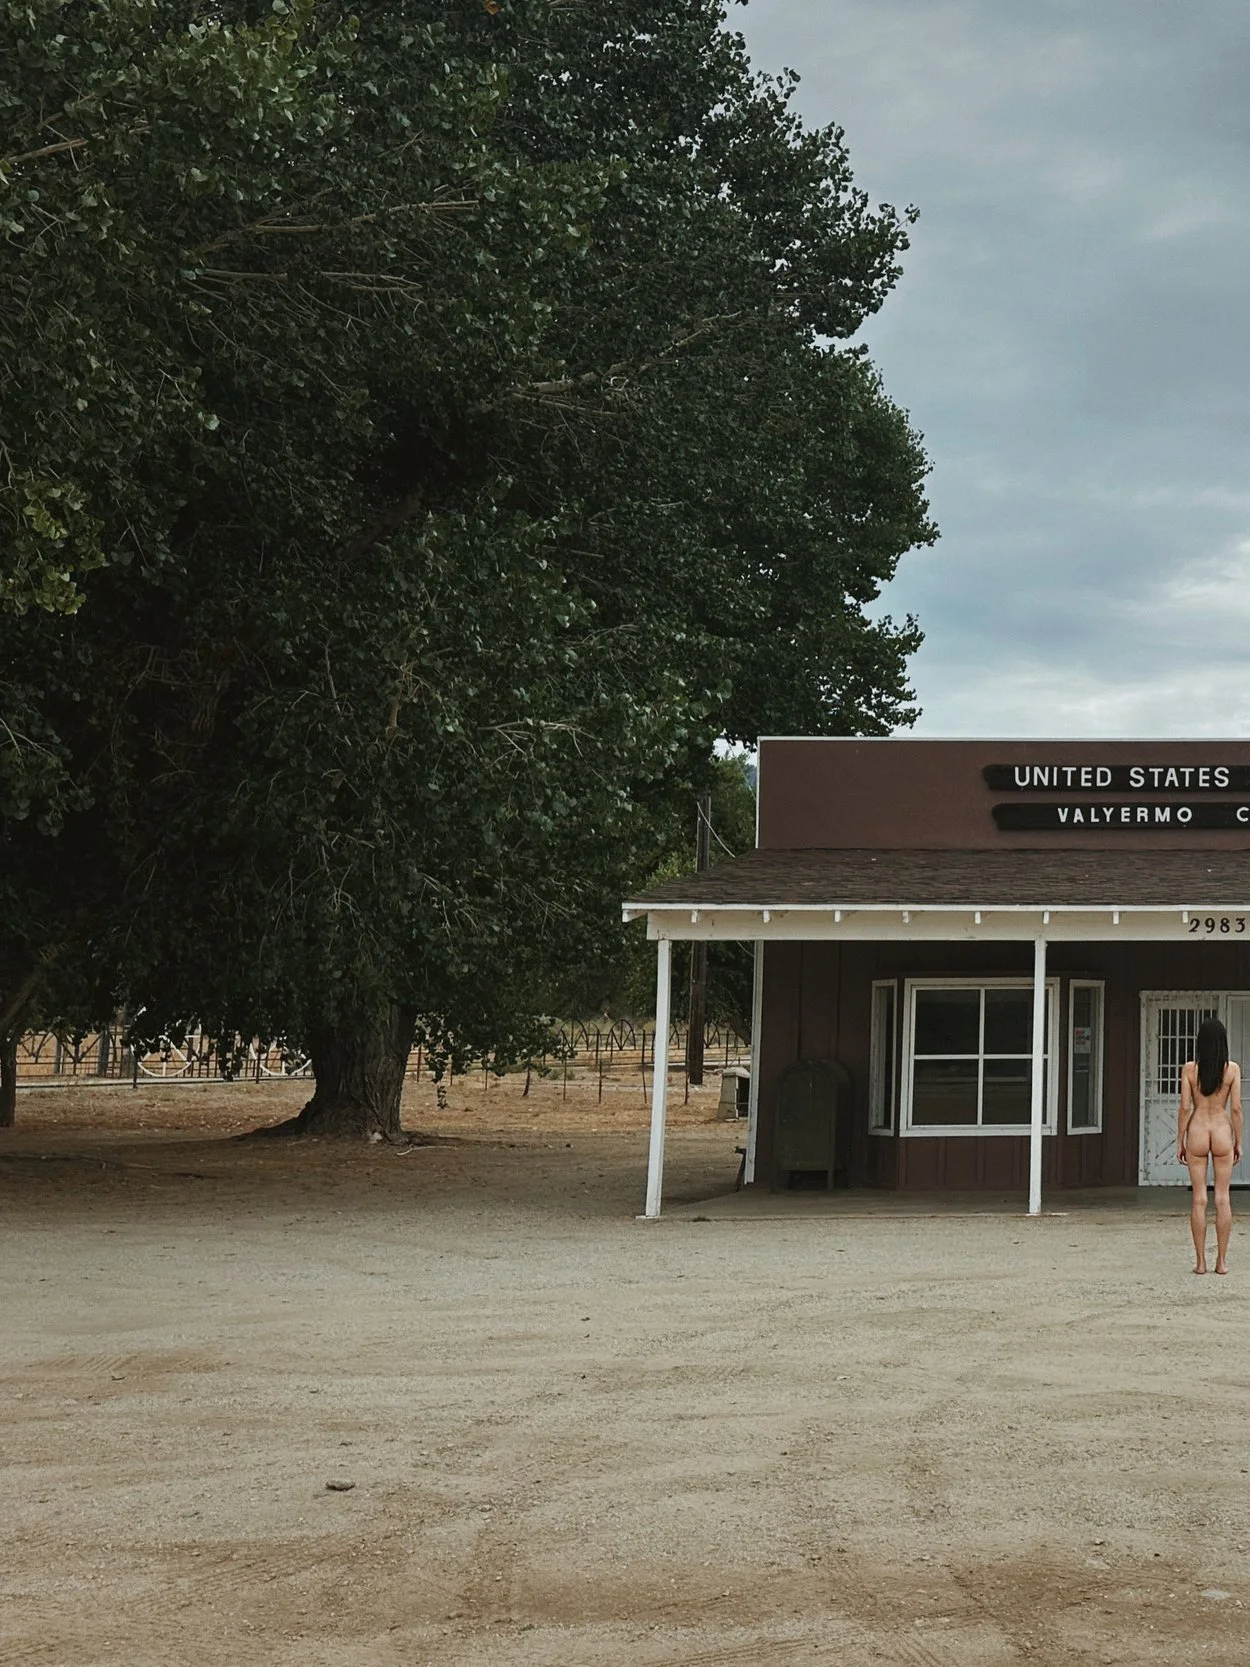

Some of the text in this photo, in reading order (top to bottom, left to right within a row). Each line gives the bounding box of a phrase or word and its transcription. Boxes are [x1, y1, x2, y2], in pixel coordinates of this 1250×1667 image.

[1014, 766, 1112, 787] UNITED
[1129, 766, 1230, 788] STATES
[1057, 806, 1193, 824] VALYERMO
